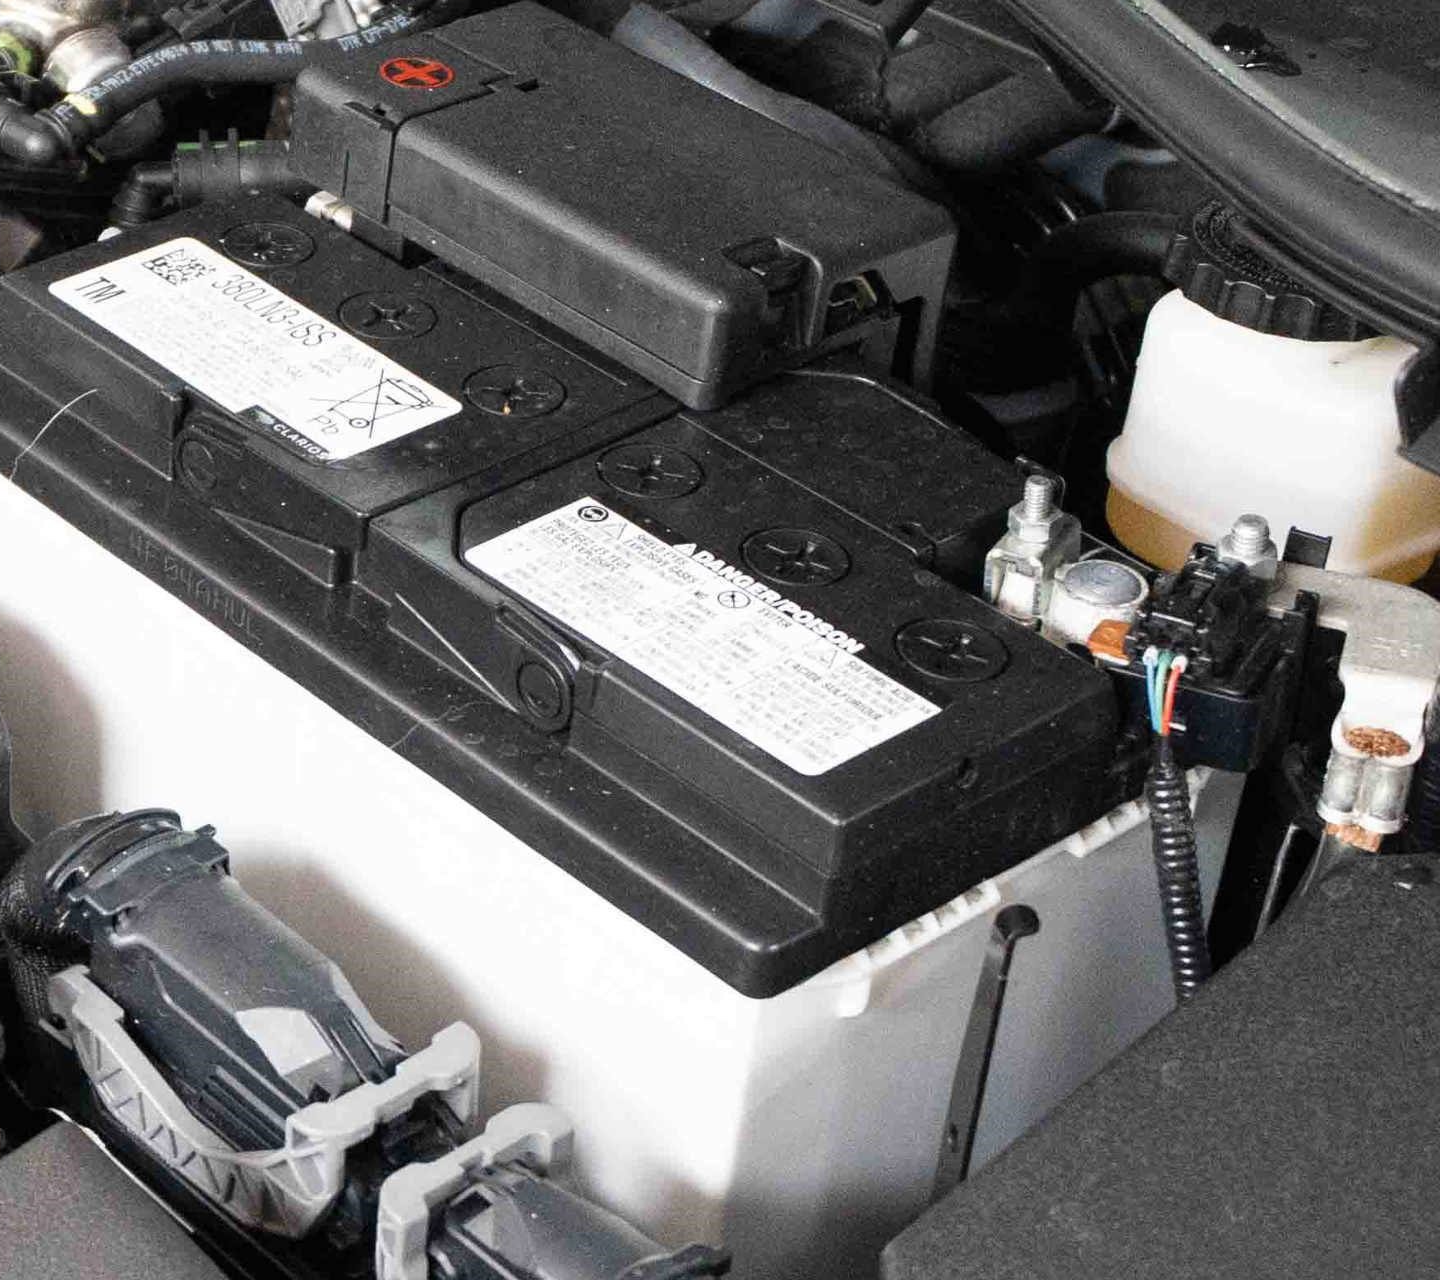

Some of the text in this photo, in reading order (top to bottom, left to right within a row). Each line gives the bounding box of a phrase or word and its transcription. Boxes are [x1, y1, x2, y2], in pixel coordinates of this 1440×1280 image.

[74, 275, 129, 304] TM
[210, 273, 337, 348] 380LN3-ISS
[310, 413, 341, 437] Pb
[693, 549, 866, 655] DANGER/POISON
